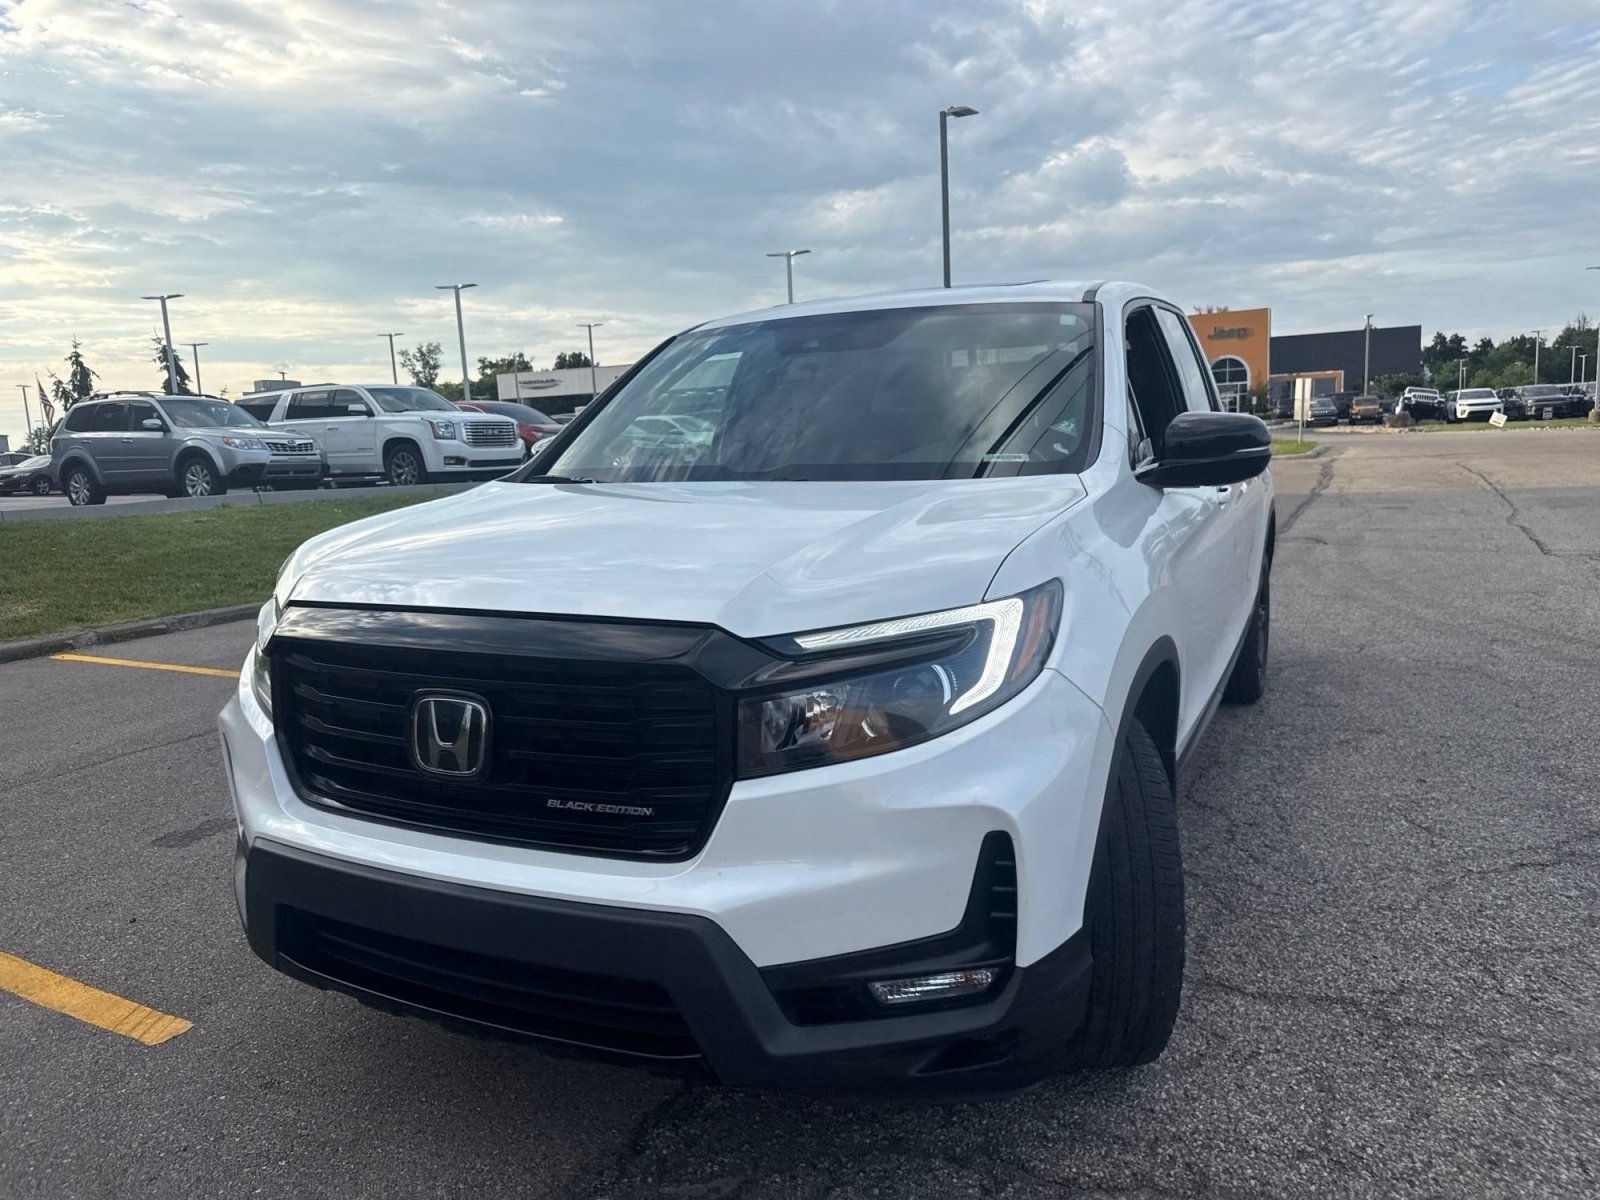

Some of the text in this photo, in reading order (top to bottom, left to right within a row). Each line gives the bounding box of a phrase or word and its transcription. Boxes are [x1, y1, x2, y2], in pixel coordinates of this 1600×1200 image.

[1208, 326, 1249, 340] Jeep
[547, 799, 654, 816] BLACK EDITION
